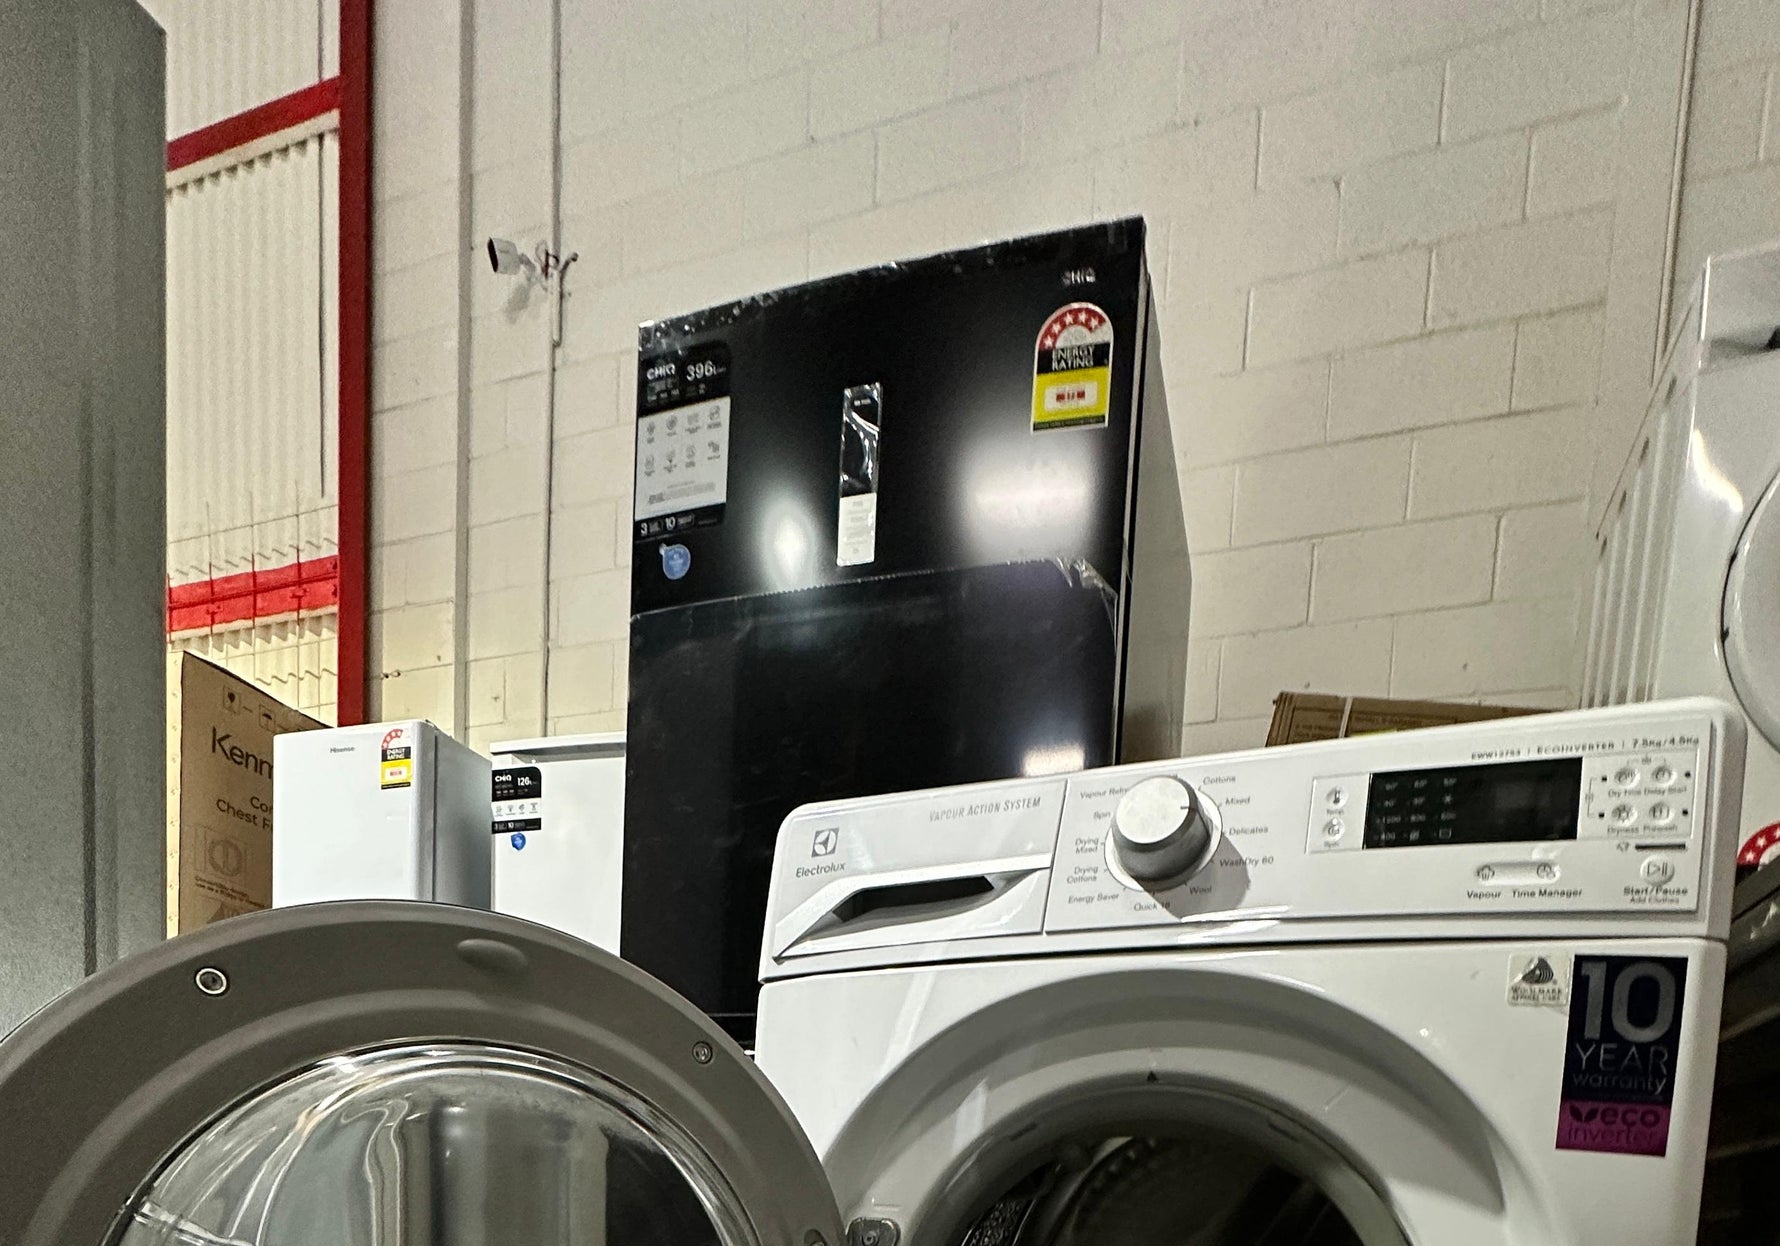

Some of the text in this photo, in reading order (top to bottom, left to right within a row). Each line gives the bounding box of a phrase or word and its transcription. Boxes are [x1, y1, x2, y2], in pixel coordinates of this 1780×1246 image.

[1052, 344, 1095, 361] ENERGY
[1052, 356, 1094, 371] RATING
[665, 516, 676, 531] 10
[1203, 775, 1236, 785] Cottons
[1080, 791, 1106, 799] Vapour
[1225, 797, 1251, 805] Mixed
[216, 799, 258, 827] Chest
[929, 796, 1041, 822] VAPOUR ACTION SYSTEM
[1229, 826, 1269, 836] Delicates
[1075, 838, 1098, 846] Drying
[796, 861, 846, 878] Electrolux
[1074, 866, 1098, 875] Drying
[1189, 885, 1212, 895] Wool
[1467, 889, 1582, 900] Vapour Time Manager
[1623, 885, 1688, 896] Start/Pause
[1068, 893, 1119, 904] Energy Saver
[1134, 903, 1157, 912] Quick
[1581, 961, 1676, 1043] 10
[1576, 1042, 1669, 1075] YEAR
[1572, 1073, 1667, 1095] warranty
[1601, 1106, 1660, 1127] eco
